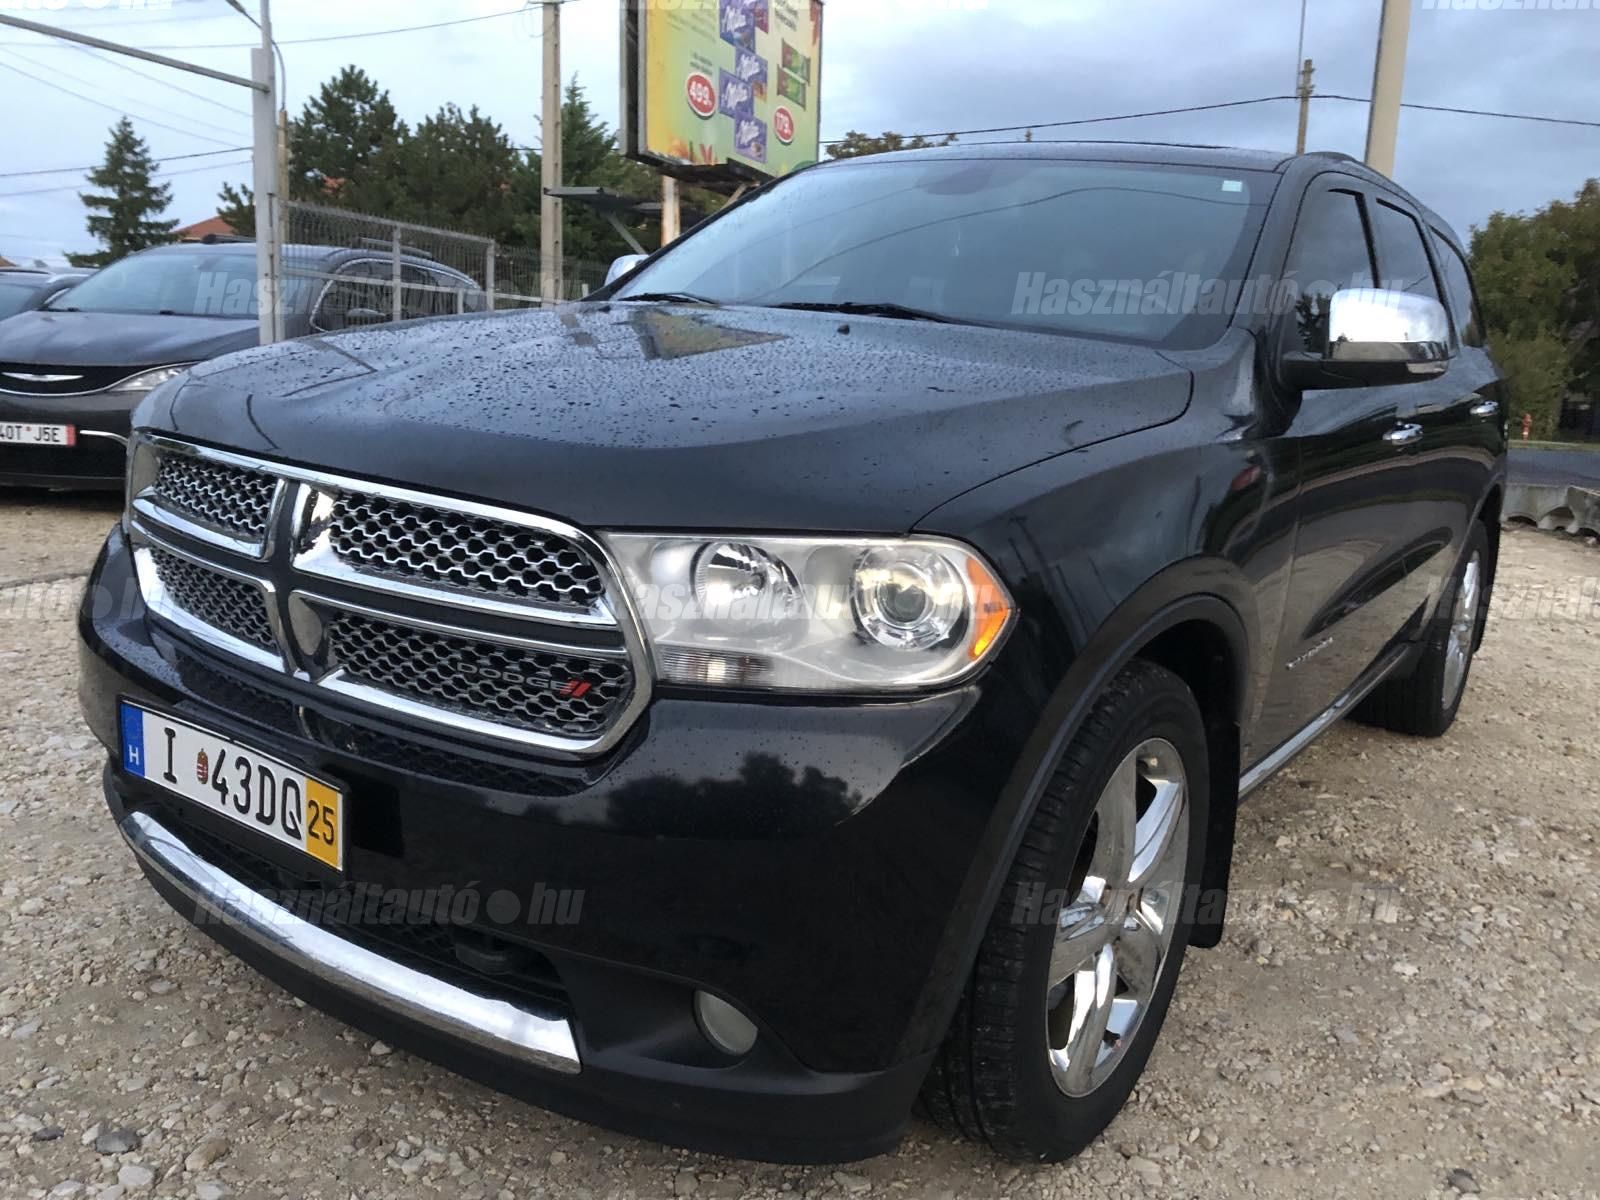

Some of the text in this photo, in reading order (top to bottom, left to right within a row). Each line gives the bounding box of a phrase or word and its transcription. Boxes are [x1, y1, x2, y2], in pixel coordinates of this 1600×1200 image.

[456, 661, 572, 693] DODGE
[128, 744, 140, 766] H
[163, 726, 335, 845] I 43DQ 25
